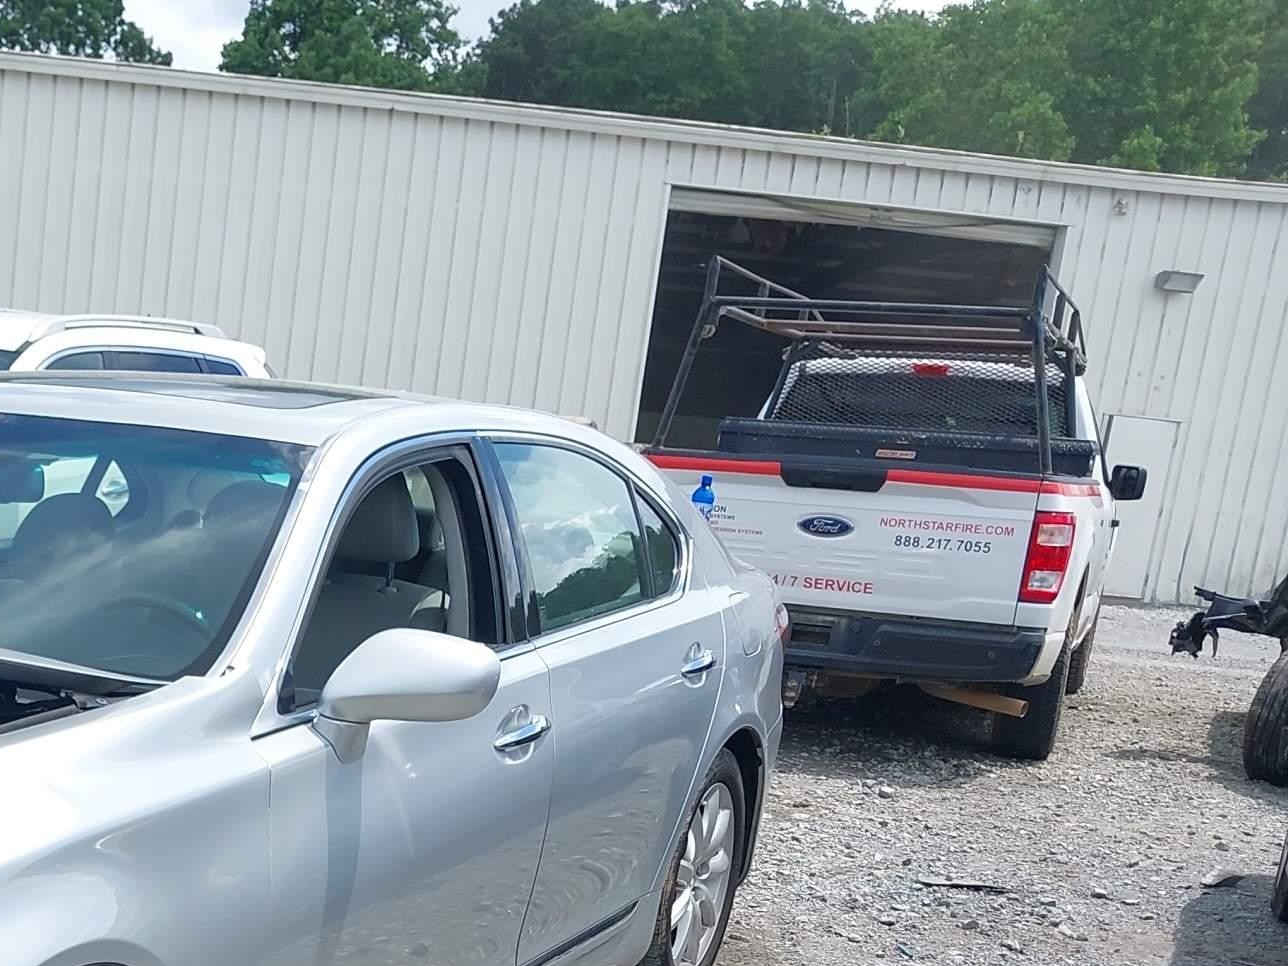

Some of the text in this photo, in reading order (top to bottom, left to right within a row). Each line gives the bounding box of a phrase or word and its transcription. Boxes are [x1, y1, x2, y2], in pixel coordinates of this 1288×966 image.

[809, 518, 842, 534] Ford
[879, 517, 1015, 537] NORTHSTARFIRE.COM
[894, 535, 992, 554] 888.217.7055
[803, 577, 874, 594] SERVICE
